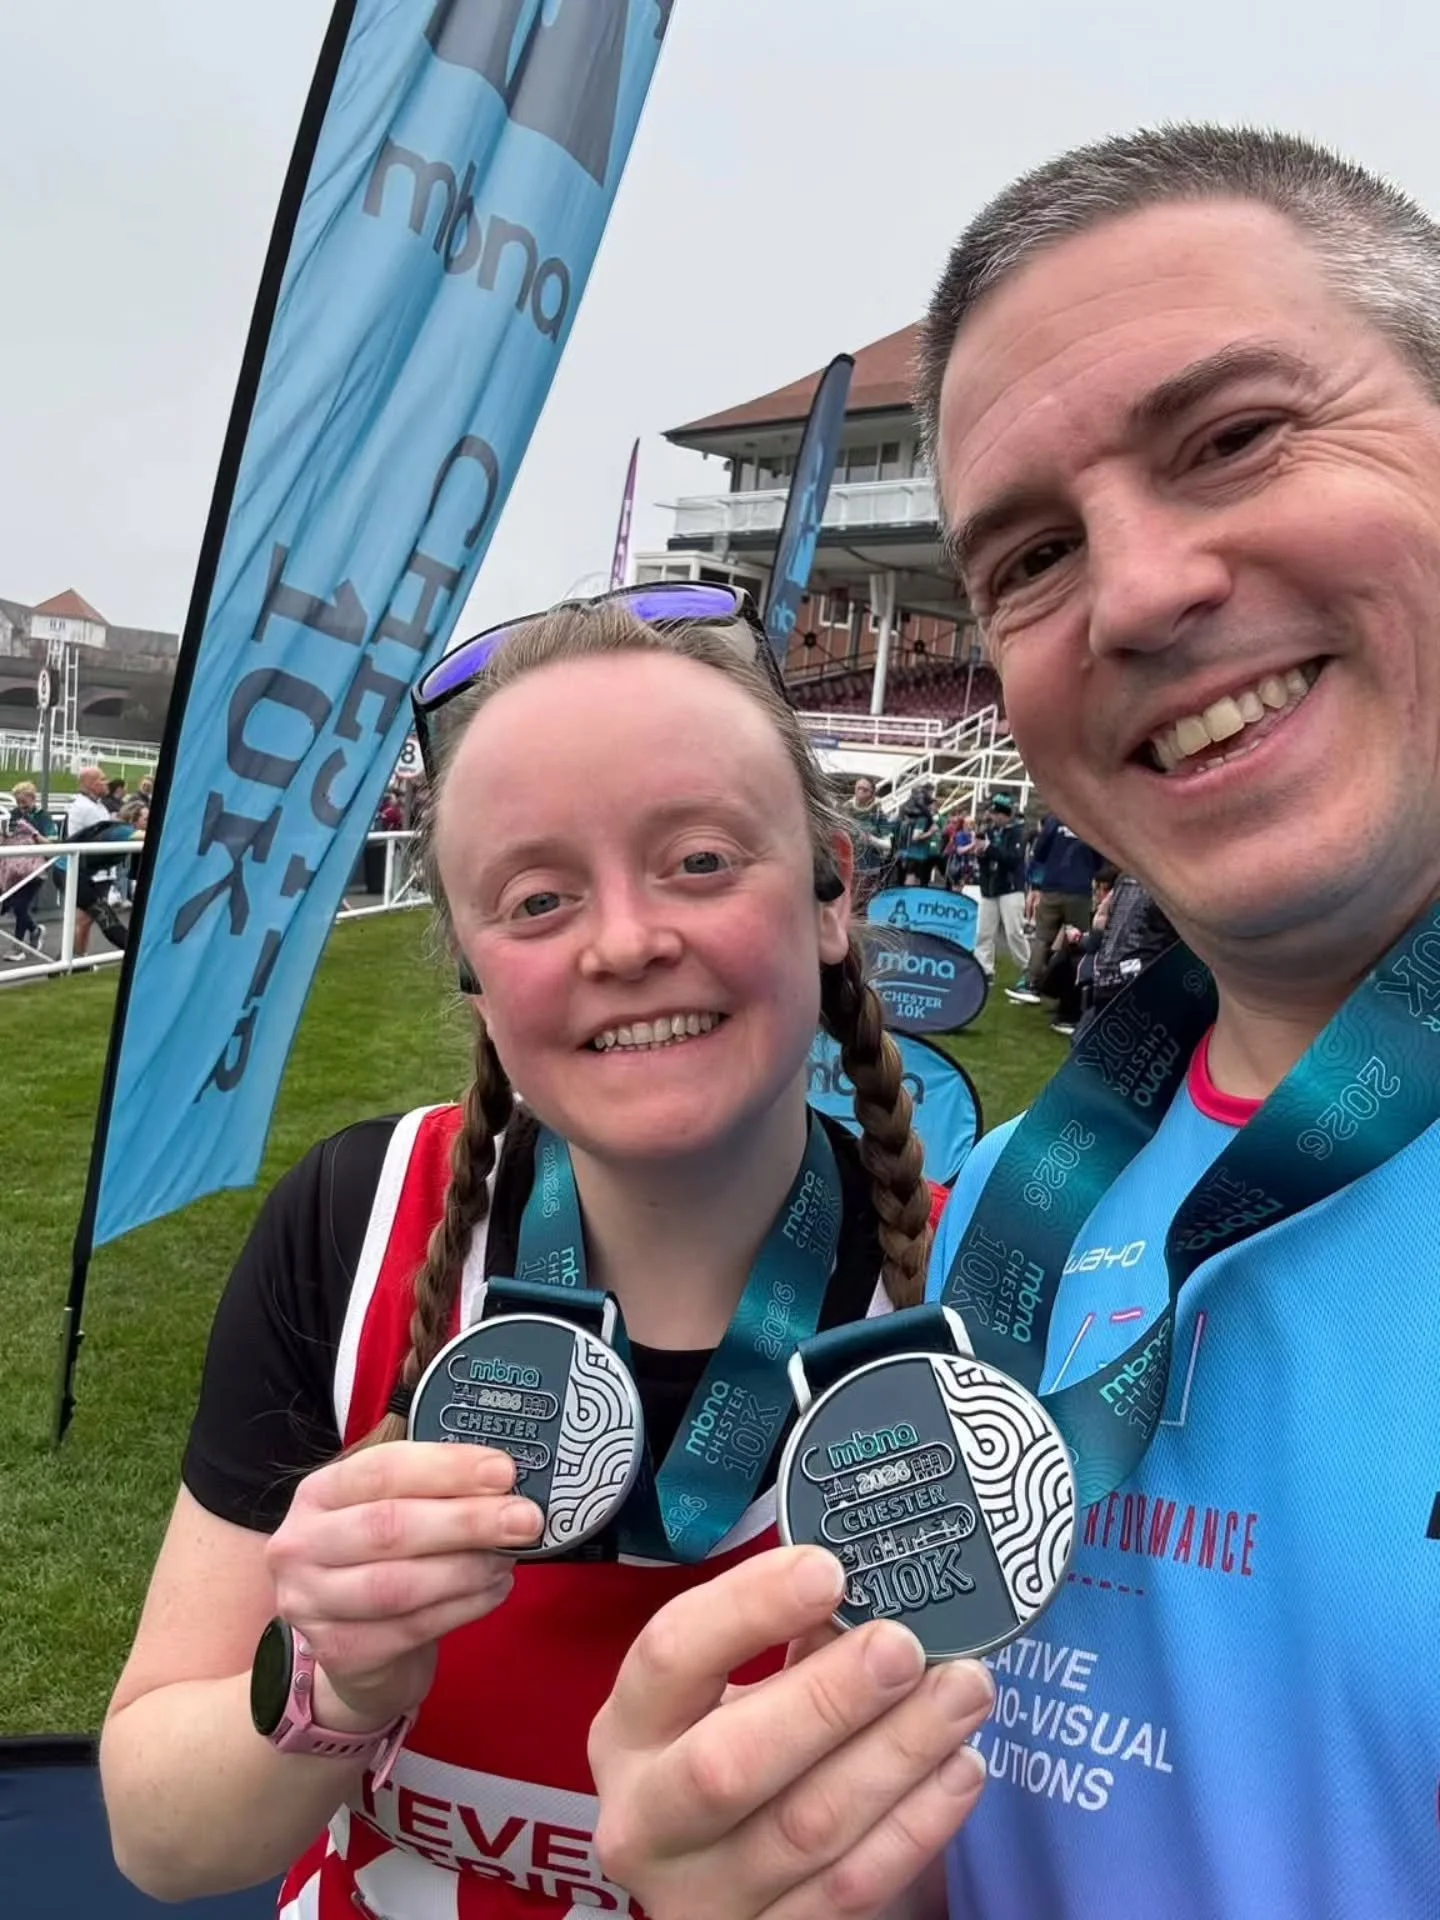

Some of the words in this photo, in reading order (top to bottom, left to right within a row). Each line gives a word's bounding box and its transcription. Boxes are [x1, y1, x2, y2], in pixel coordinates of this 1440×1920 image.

[363, 136, 570, 343] mbna
[171, 542, 367, 944] 10K
[401, 743, 415, 764] 8
[917, 902, 969, 921] mbna
[877, 951, 955, 979] mbna
[882, 990, 942, 1009] CHESTER
[896, 1004, 926, 1019] 10K
[1075, 991, 1150, 1085] 10K
[1112, 1023, 1168, 1097] CHESTER
[1133, 1038, 1180, 1107] mbna
[1297, 1056, 1400, 1160] 2026
[1023, 1119, 1096, 1211] 2026
[783, 1170, 815, 1239] mbna
[796, 1176, 825, 1248] CHESTER
[948, 1224, 1008, 1325] 10K
[991, 1249, 1025, 1336] CHESTER
[1012, 1261, 1045, 1343] mbna
[754, 1281, 796, 1361] 2026
[470, 1358, 541, 1388] mbna
[1099, 1317, 1171, 1404] mbna
[456, 1412, 539, 1439] CHESTER
[477, 1389, 523, 1411] 2026
[685, 1380, 731, 1456] mbna
[705, 1386, 748, 1465] CHESTER
[721, 1394, 781, 1481] 10K
[827, 1423, 919, 1470] mbna
[855, 1459, 912, 1494] 2026
[842, 1483, 947, 1534] CHESTER
[862, 1543, 976, 1619] 10K
[987, 1685, 1173, 1773] IO-VISUAL
